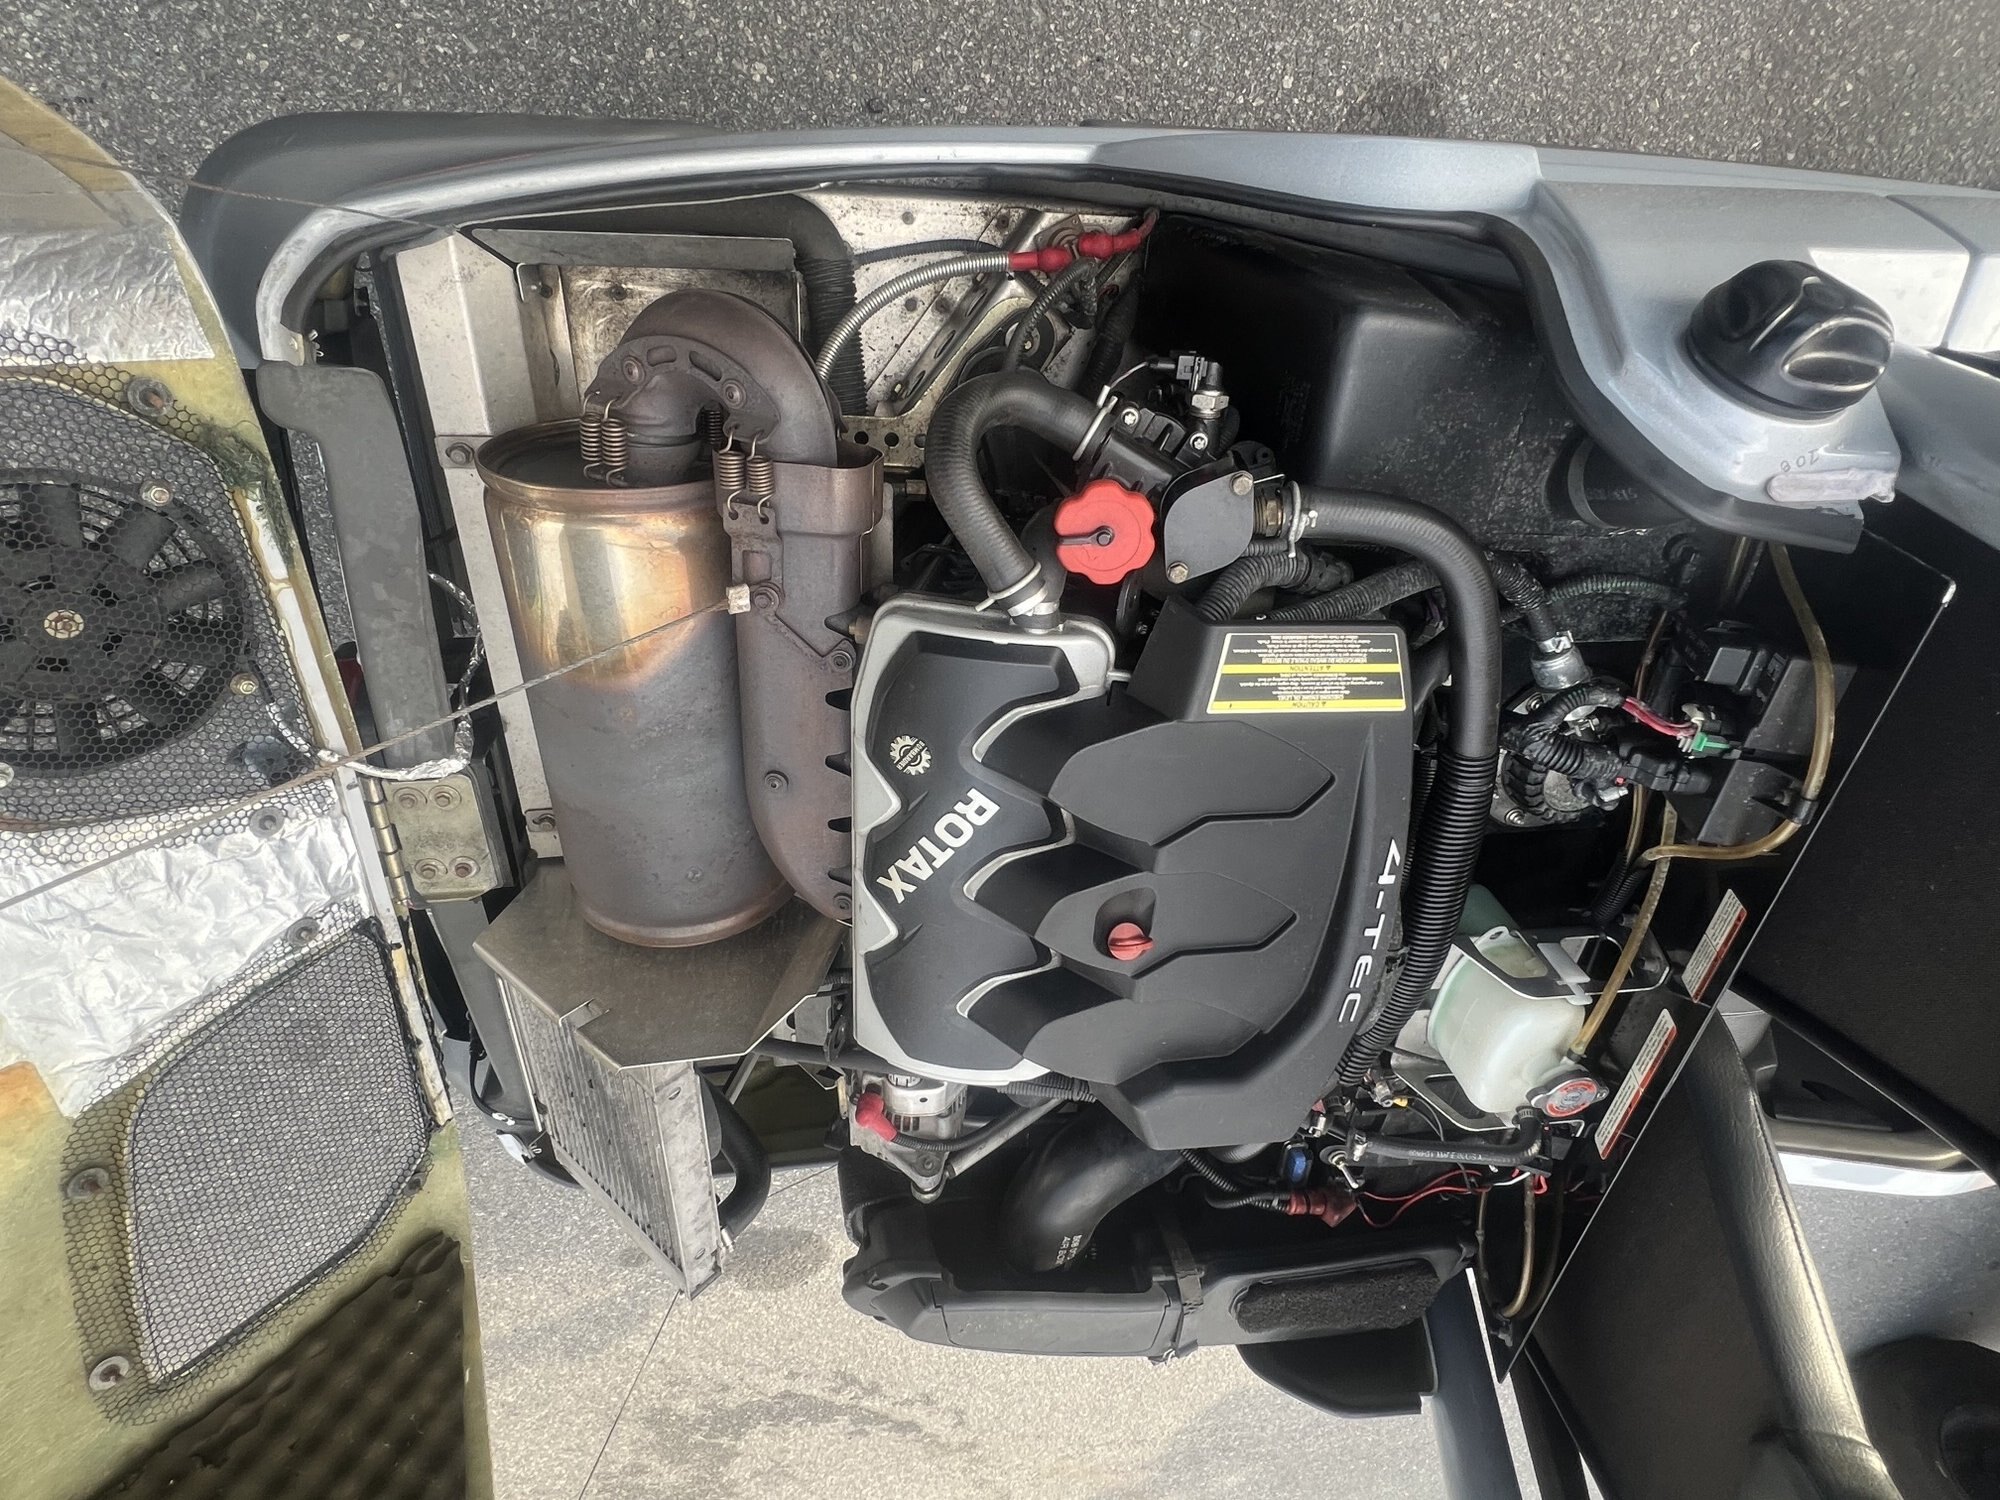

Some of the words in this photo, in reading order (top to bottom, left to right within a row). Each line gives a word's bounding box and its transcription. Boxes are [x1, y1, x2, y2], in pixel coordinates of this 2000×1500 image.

[896, 740, 926, 770] BOMBARDIER
[876, 787, 1001, 904] ROTAX
[1338, 837, 1401, 1023] 4-TEC
